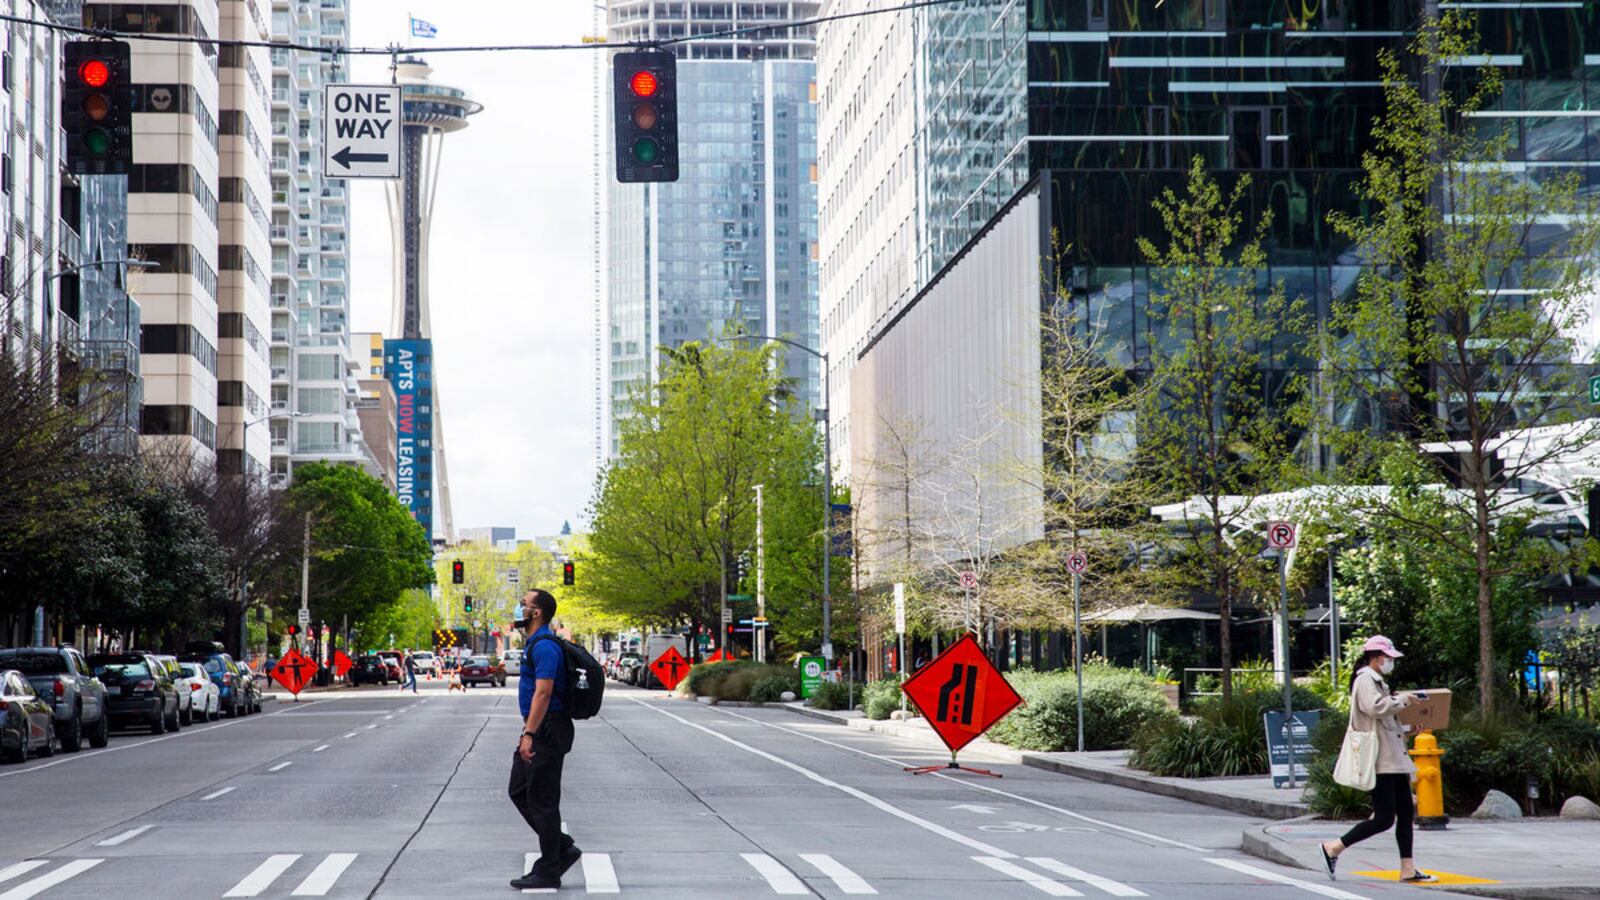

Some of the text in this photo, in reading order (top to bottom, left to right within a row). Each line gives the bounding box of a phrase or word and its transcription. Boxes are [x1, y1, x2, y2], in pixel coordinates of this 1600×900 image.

[334, 92, 391, 114] ONE
[334, 118, 392, 139] WAY
[398, 348, 414, 505] APTS NOW LEASING
